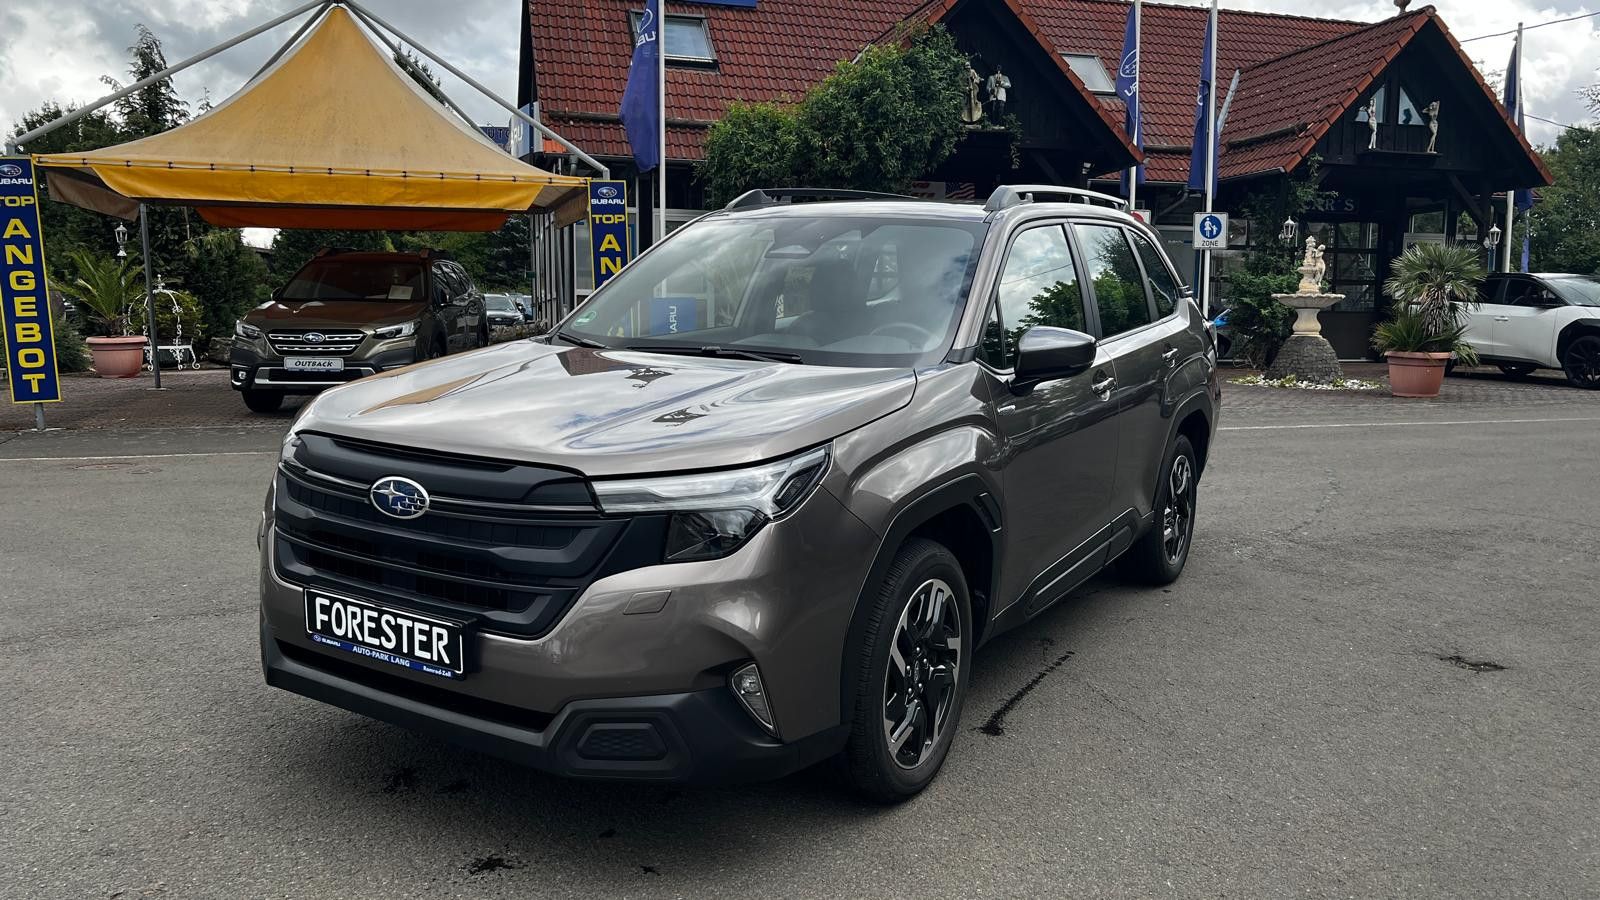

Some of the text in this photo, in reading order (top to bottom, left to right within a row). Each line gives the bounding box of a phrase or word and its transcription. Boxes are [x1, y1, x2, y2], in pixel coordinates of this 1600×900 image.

[592, 214, 625, 224] TOP
[599, 233, 622, 284] AN
[3, 218, 46, 393] ANGEBOT
[315, 597, 450, 665] FORESTER
[352, 645, 410, 667] AUTO-PARK LANG
